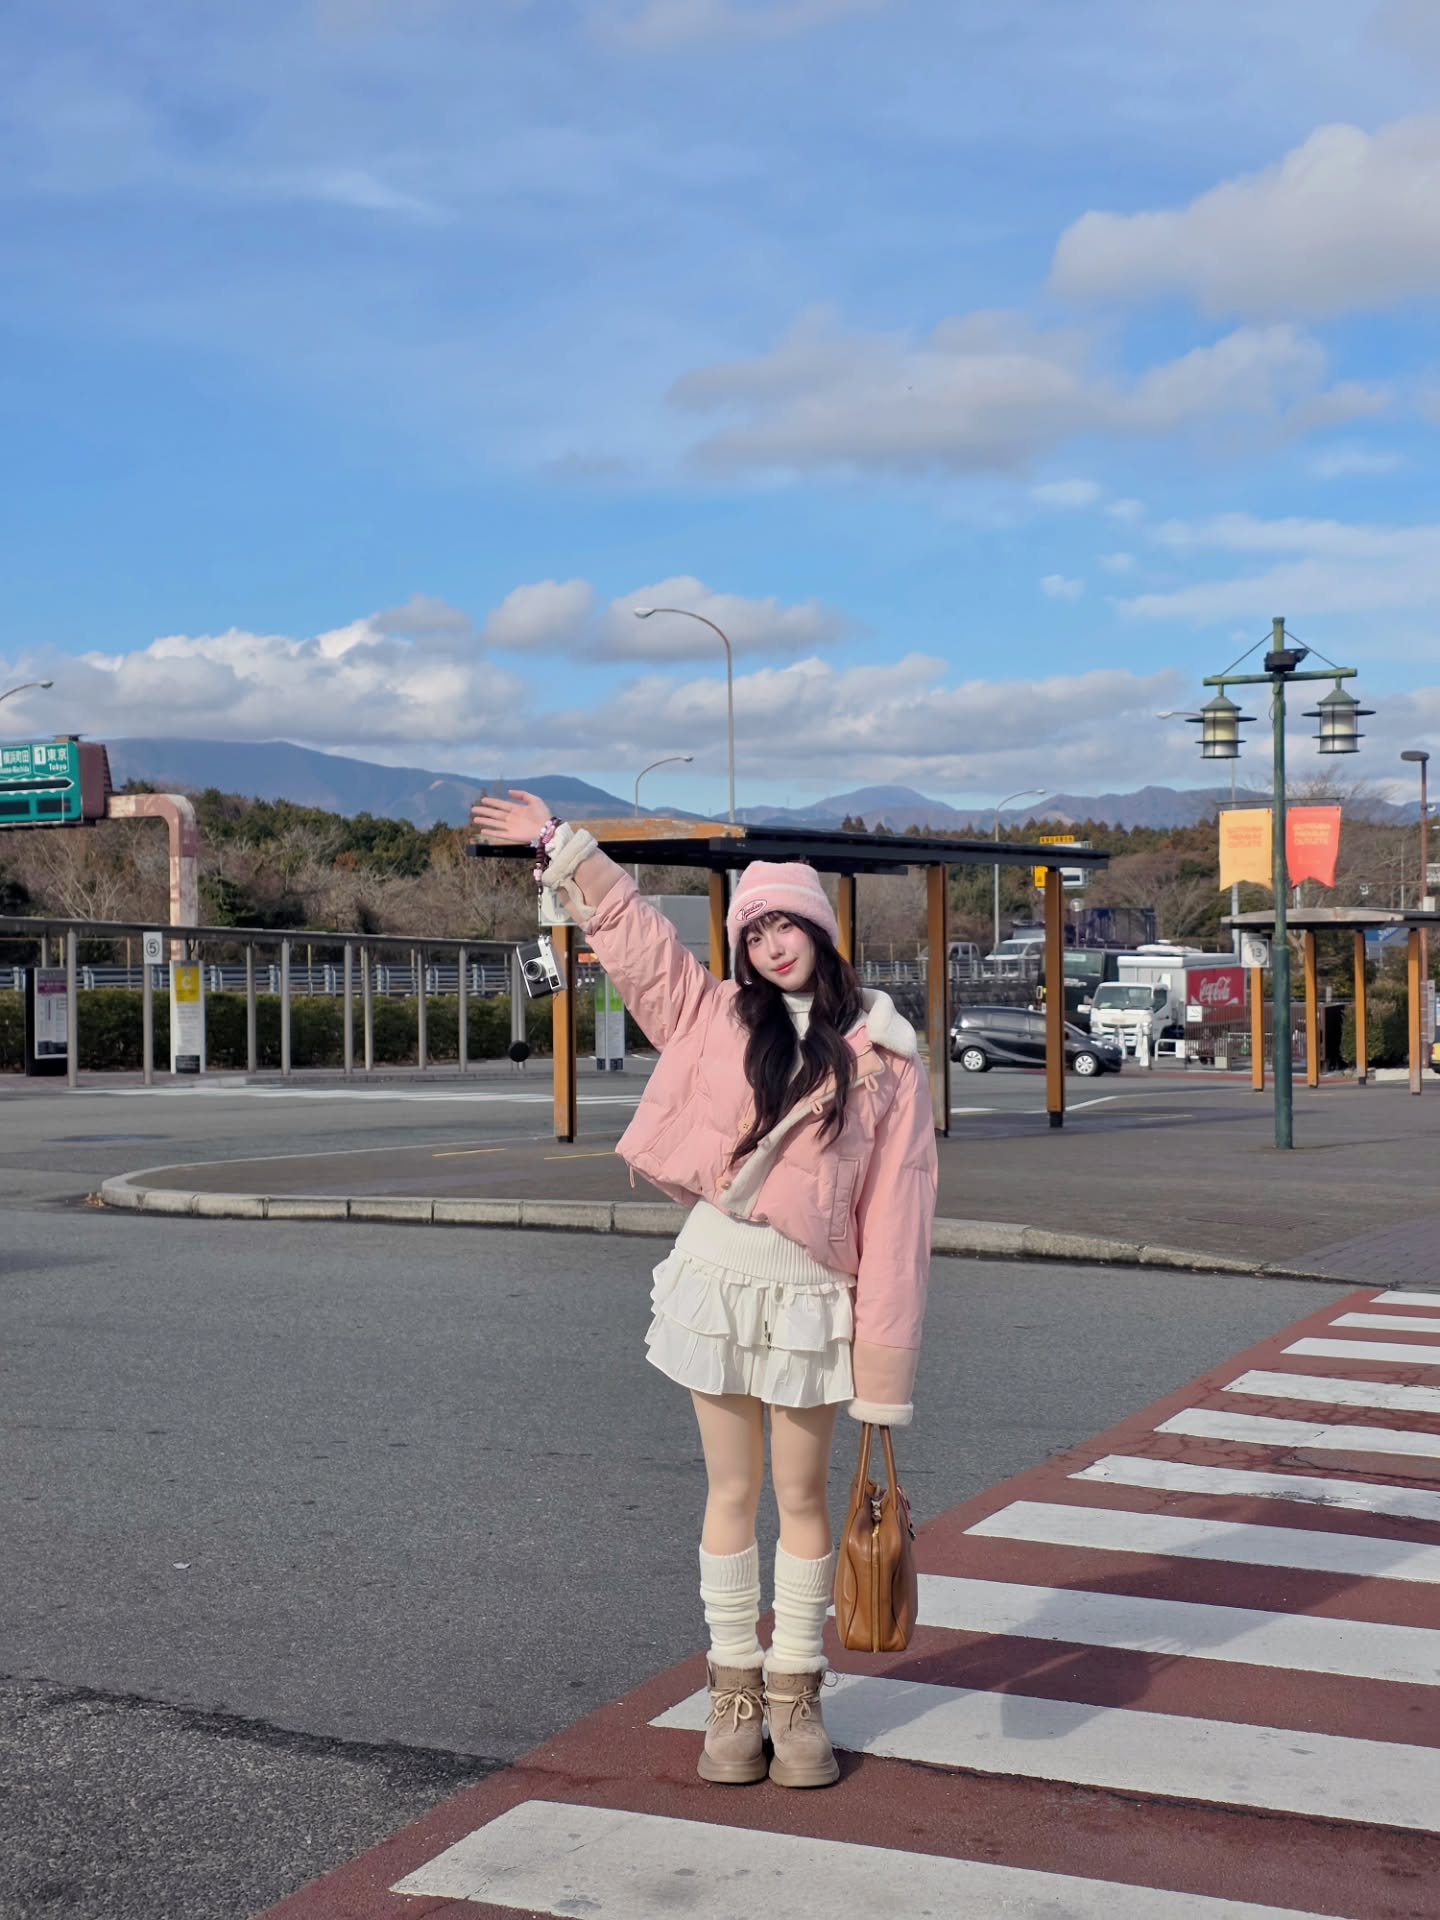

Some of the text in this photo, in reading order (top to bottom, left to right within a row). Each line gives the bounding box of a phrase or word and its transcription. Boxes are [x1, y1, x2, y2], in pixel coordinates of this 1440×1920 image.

[38, 749, 43, 762] 1
[47, 748, 67, 761] 東京
[48, 762, 67, 772] Tokyo
[149, 942, 157, 954] 5
[1252, 948, 1262, 958] 13
[182, 978, 192, 990] C
